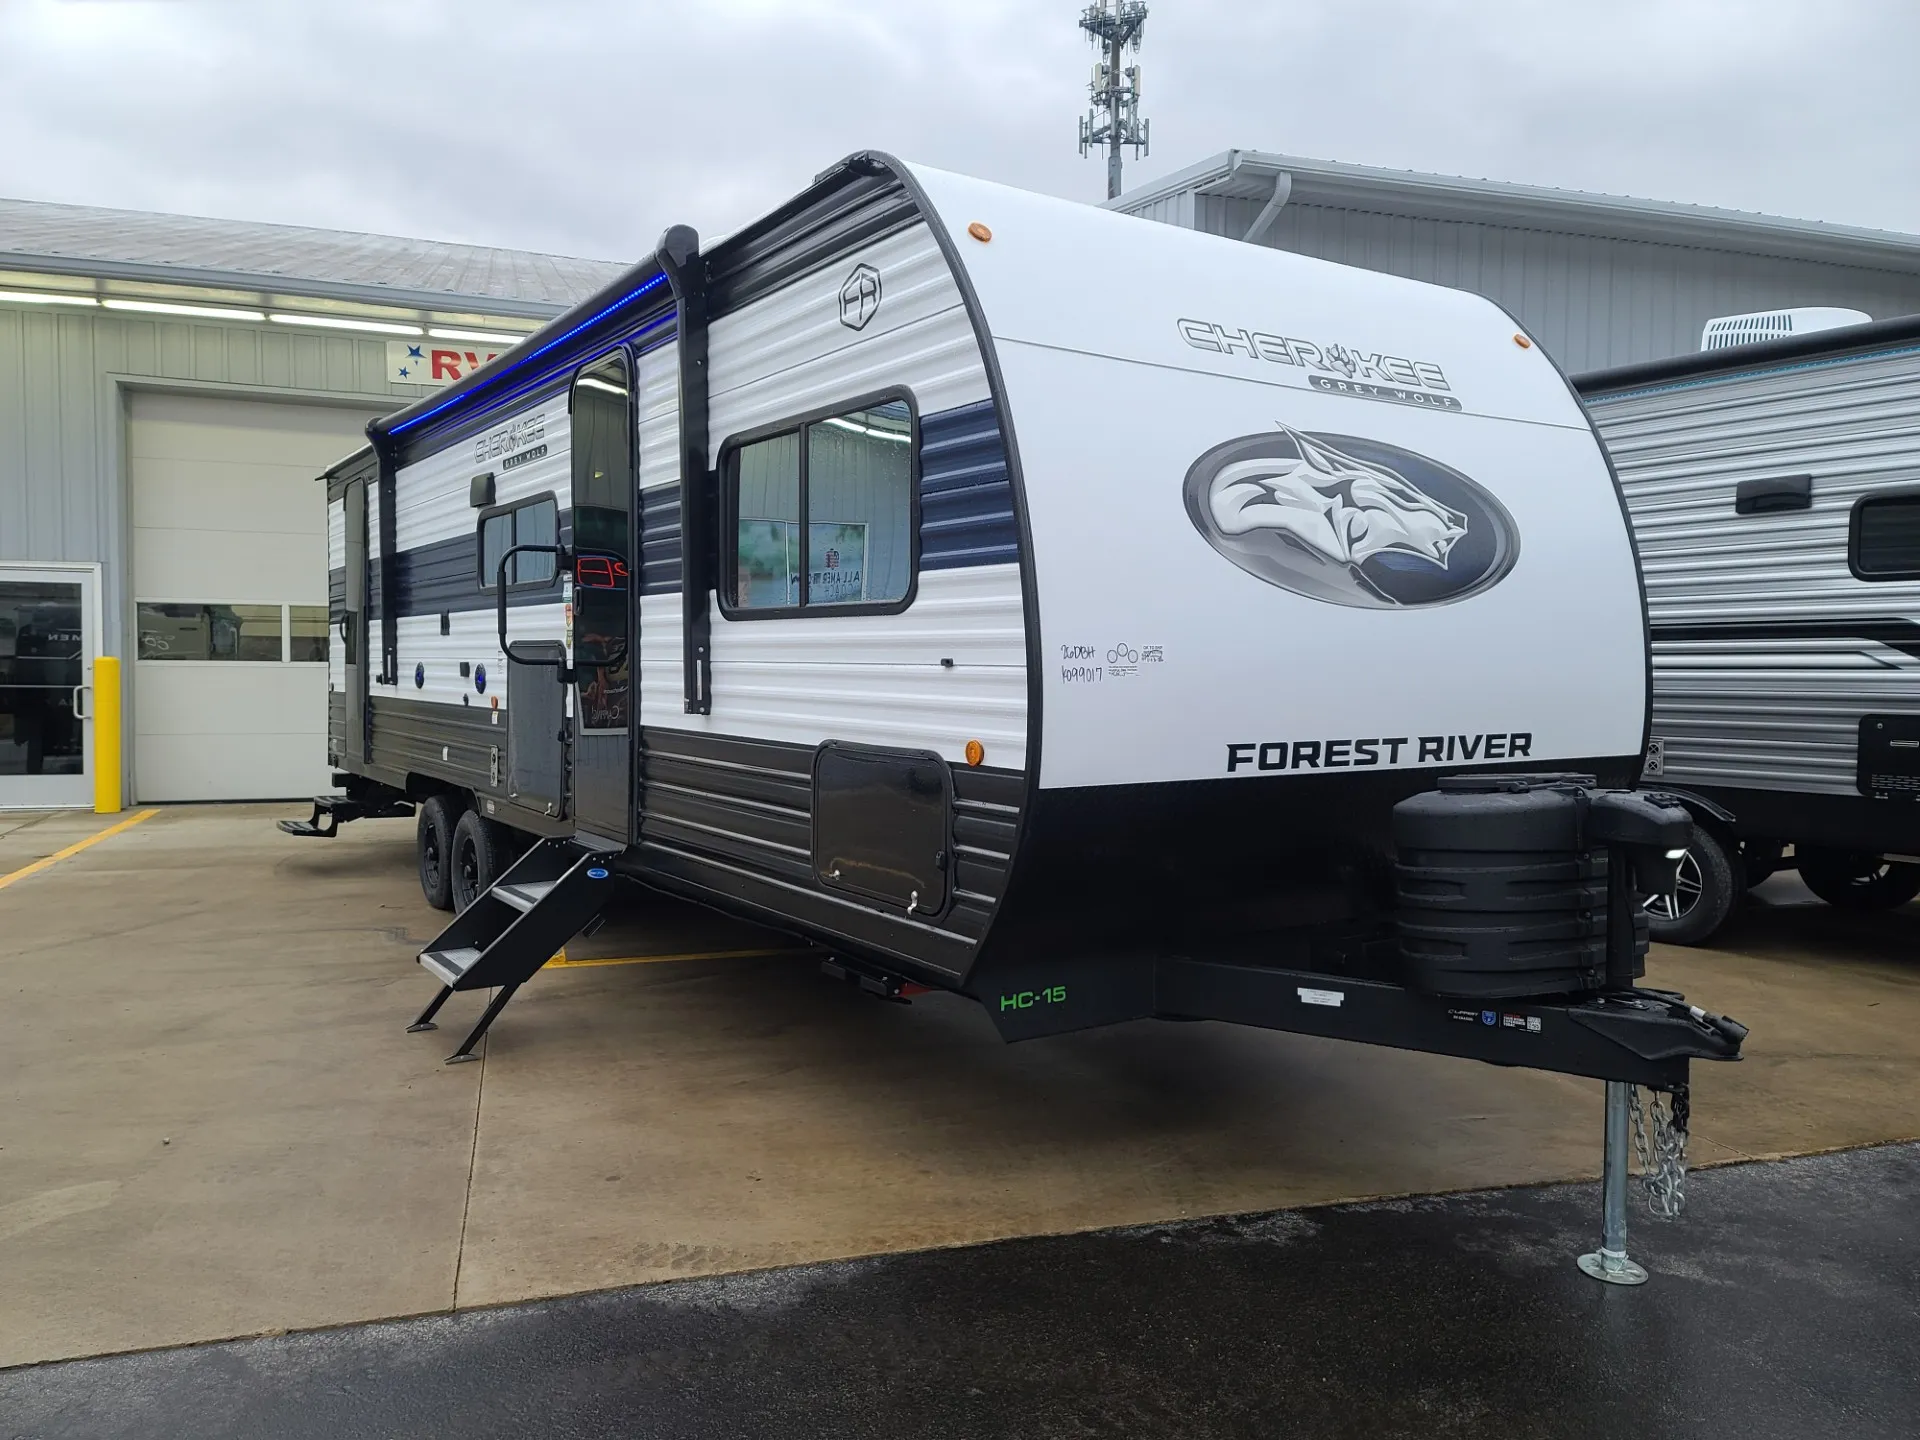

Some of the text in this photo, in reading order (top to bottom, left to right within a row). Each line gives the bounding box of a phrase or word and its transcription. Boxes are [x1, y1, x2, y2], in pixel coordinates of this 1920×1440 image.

[1319, 378, 1453, 407] GREY WOLF
[525, 446, 545, 460] WOLF
[1226, 732, 1533, 772] FOREST RIVER
[1000, 985, 1067, 1012] HC-15
